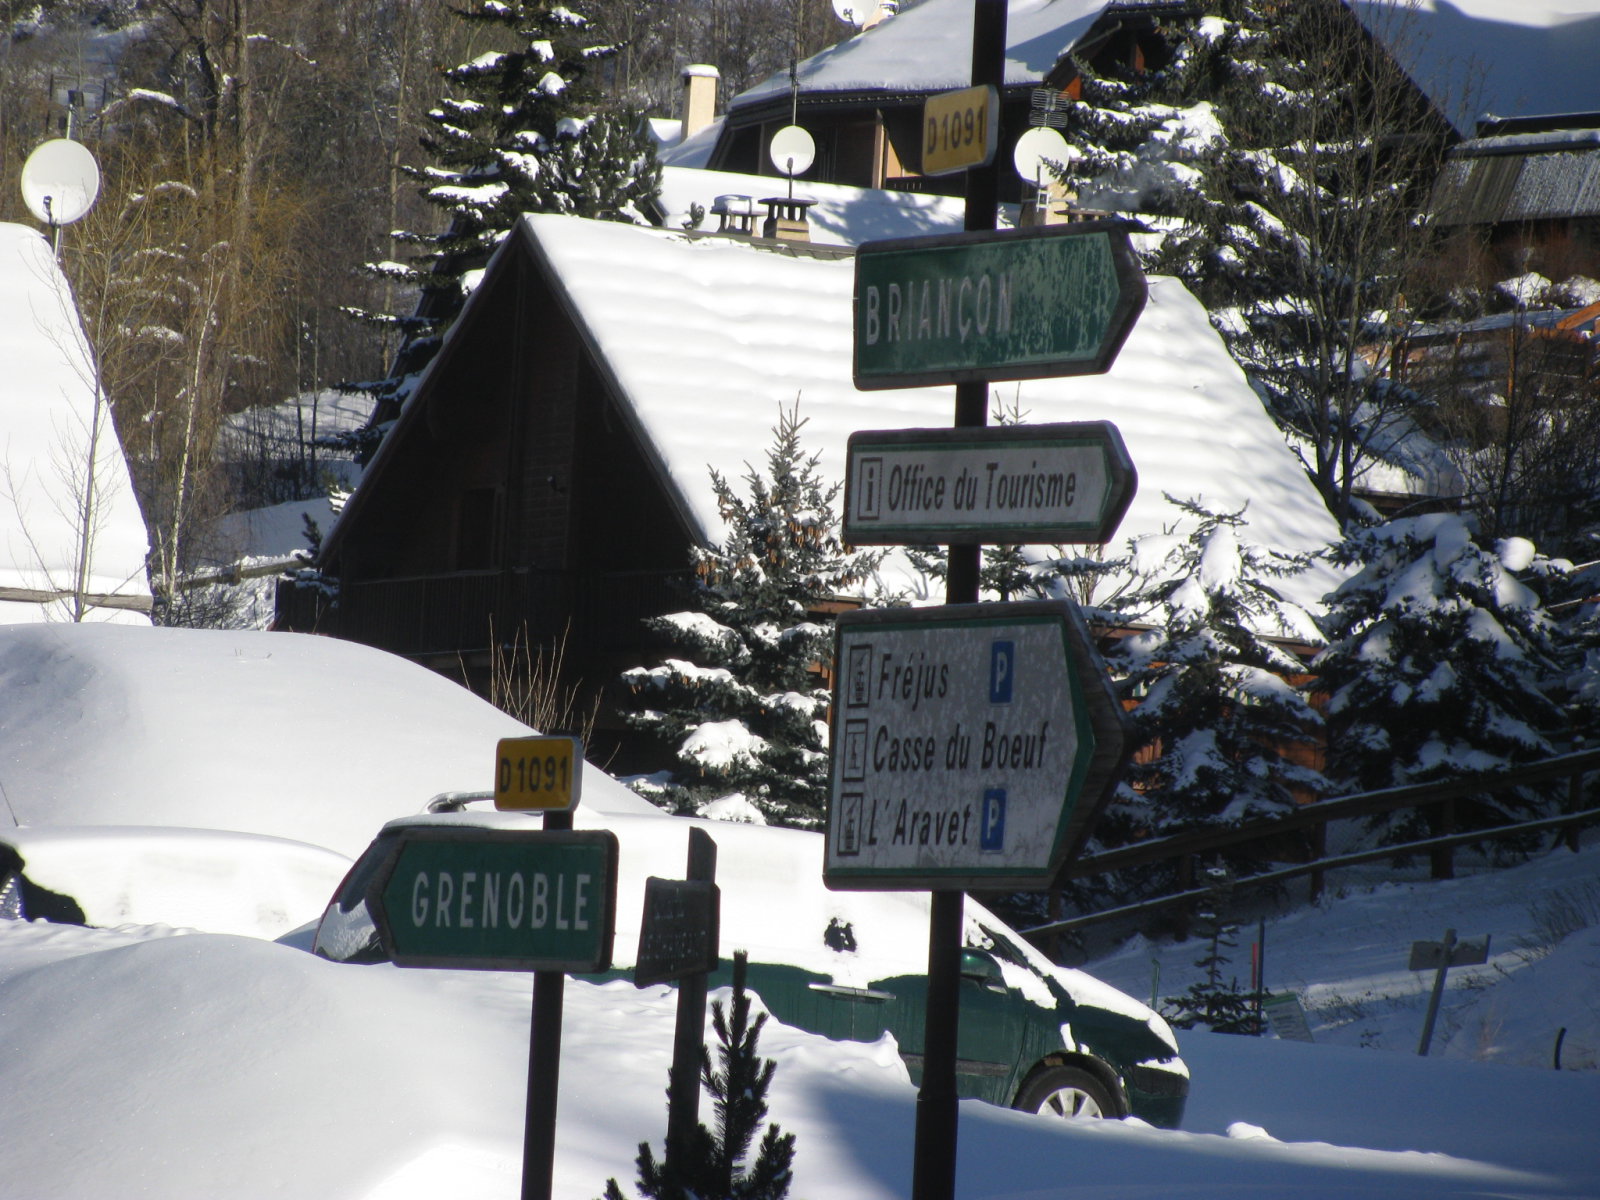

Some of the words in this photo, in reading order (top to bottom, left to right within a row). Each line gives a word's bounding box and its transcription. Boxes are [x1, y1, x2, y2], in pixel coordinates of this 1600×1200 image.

[866, 273, 1013, 345] BRIANÇON
[888, 463, 945, 512] Office
[954, 468, 979, 511] du
[985, 461, 1076, 510] Tourisme
[878, 653, 949, 711] Fréjus
[993, 653, 1009, 694] P
[873, 725, 936, 772] Casse
[945, 723, 971, 772] du
[981, 720, 1049, 771] Boeuf
[986, 801, 1000, 840] P
[412, 872, 591, 930] GRENOBLE
